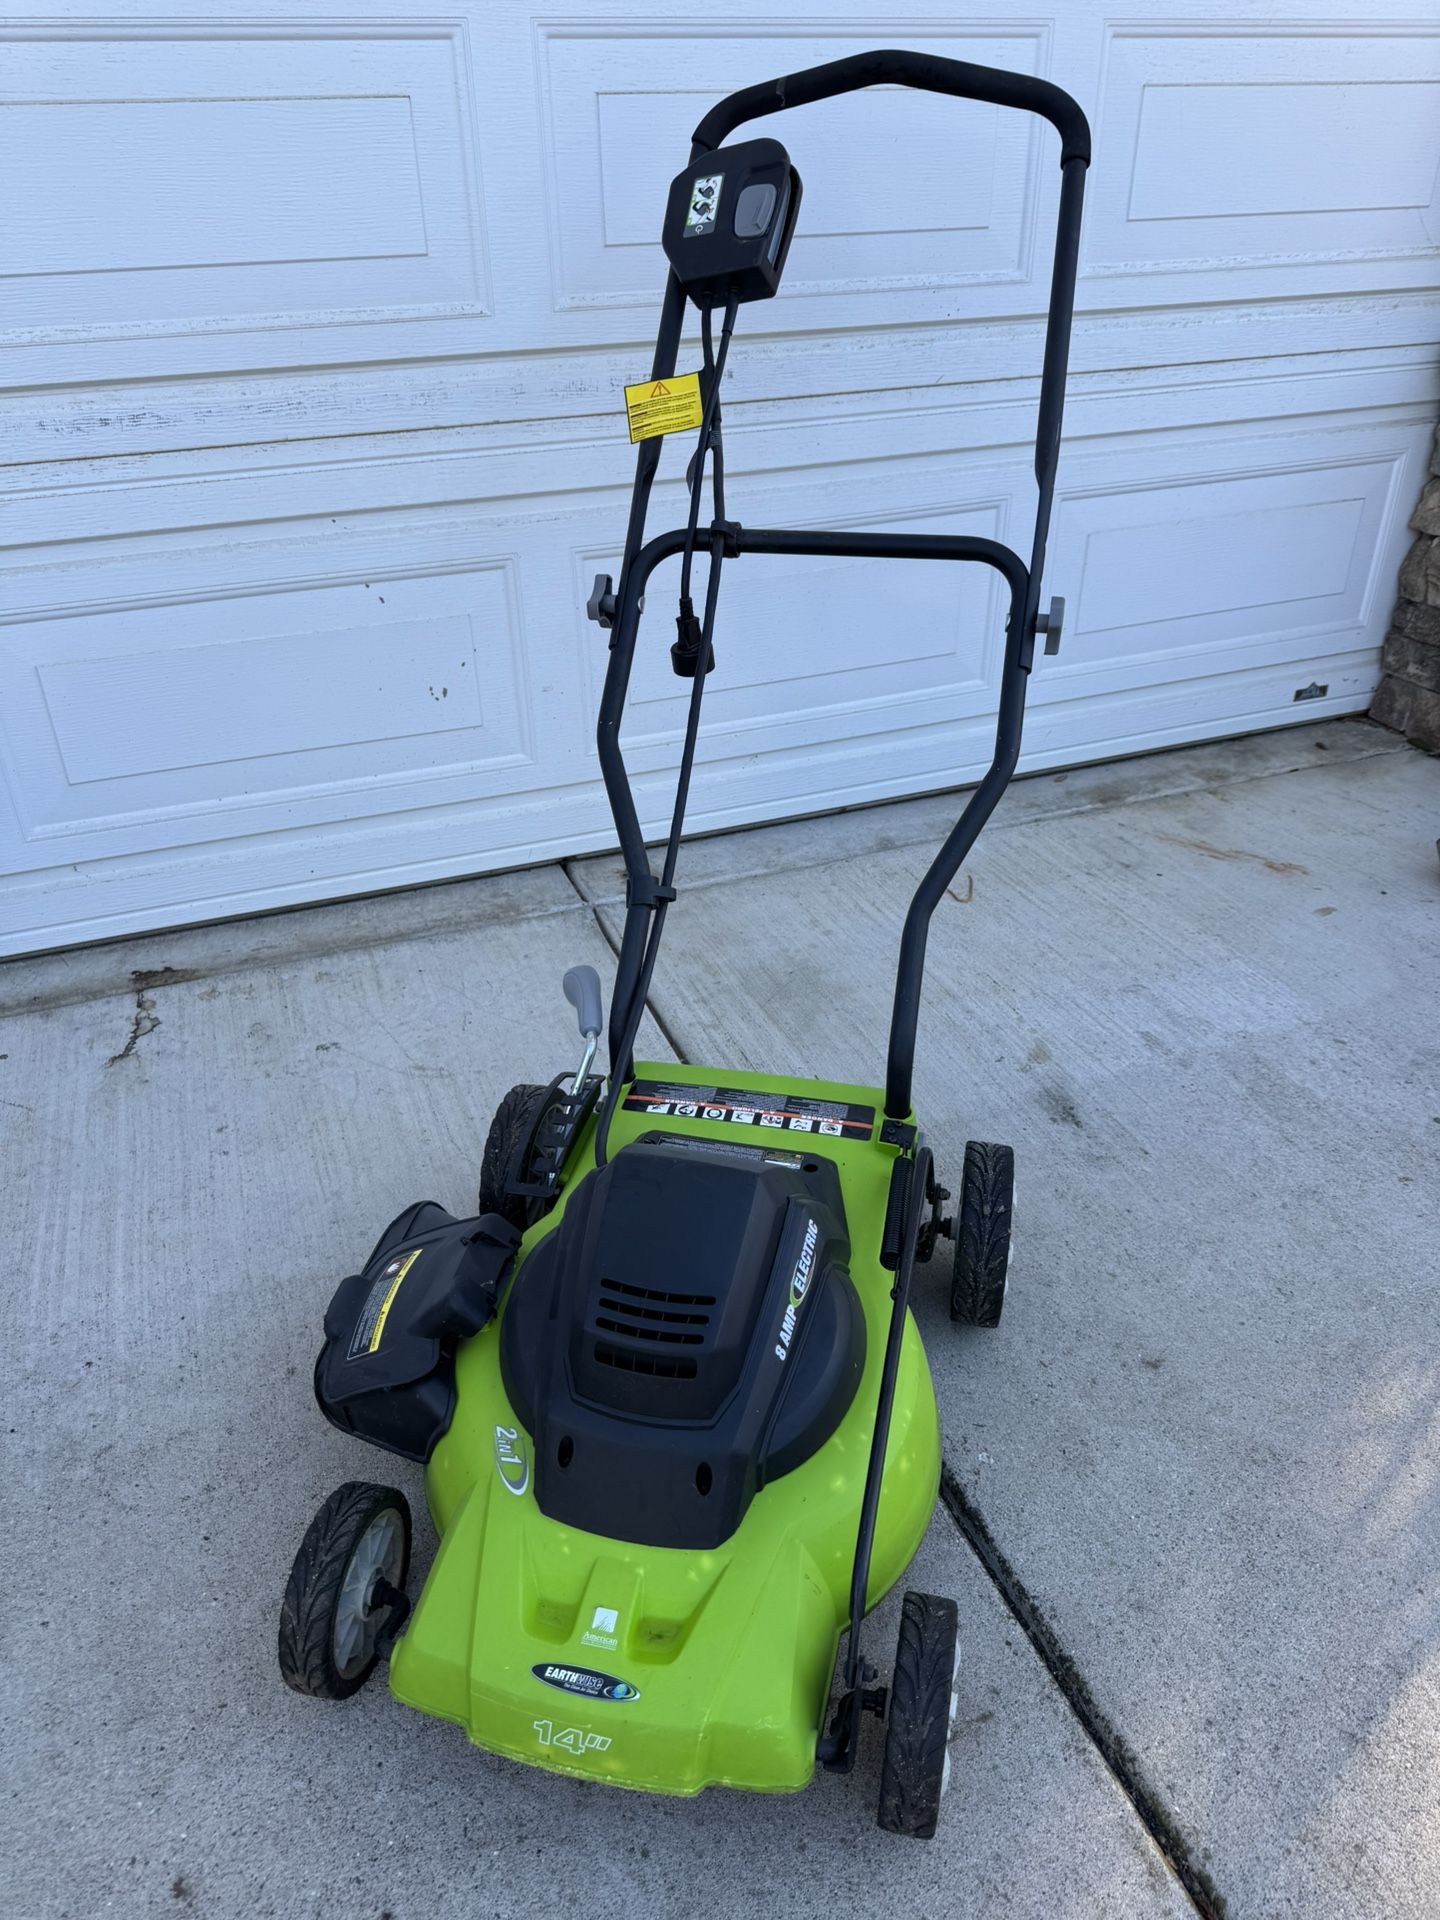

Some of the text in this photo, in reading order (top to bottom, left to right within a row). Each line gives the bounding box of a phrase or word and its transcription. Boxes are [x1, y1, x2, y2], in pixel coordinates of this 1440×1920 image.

[775, 1218, 819, 1361] 8 AMP ELECTRIC
[533, 1719, 613, 1756] 14"
